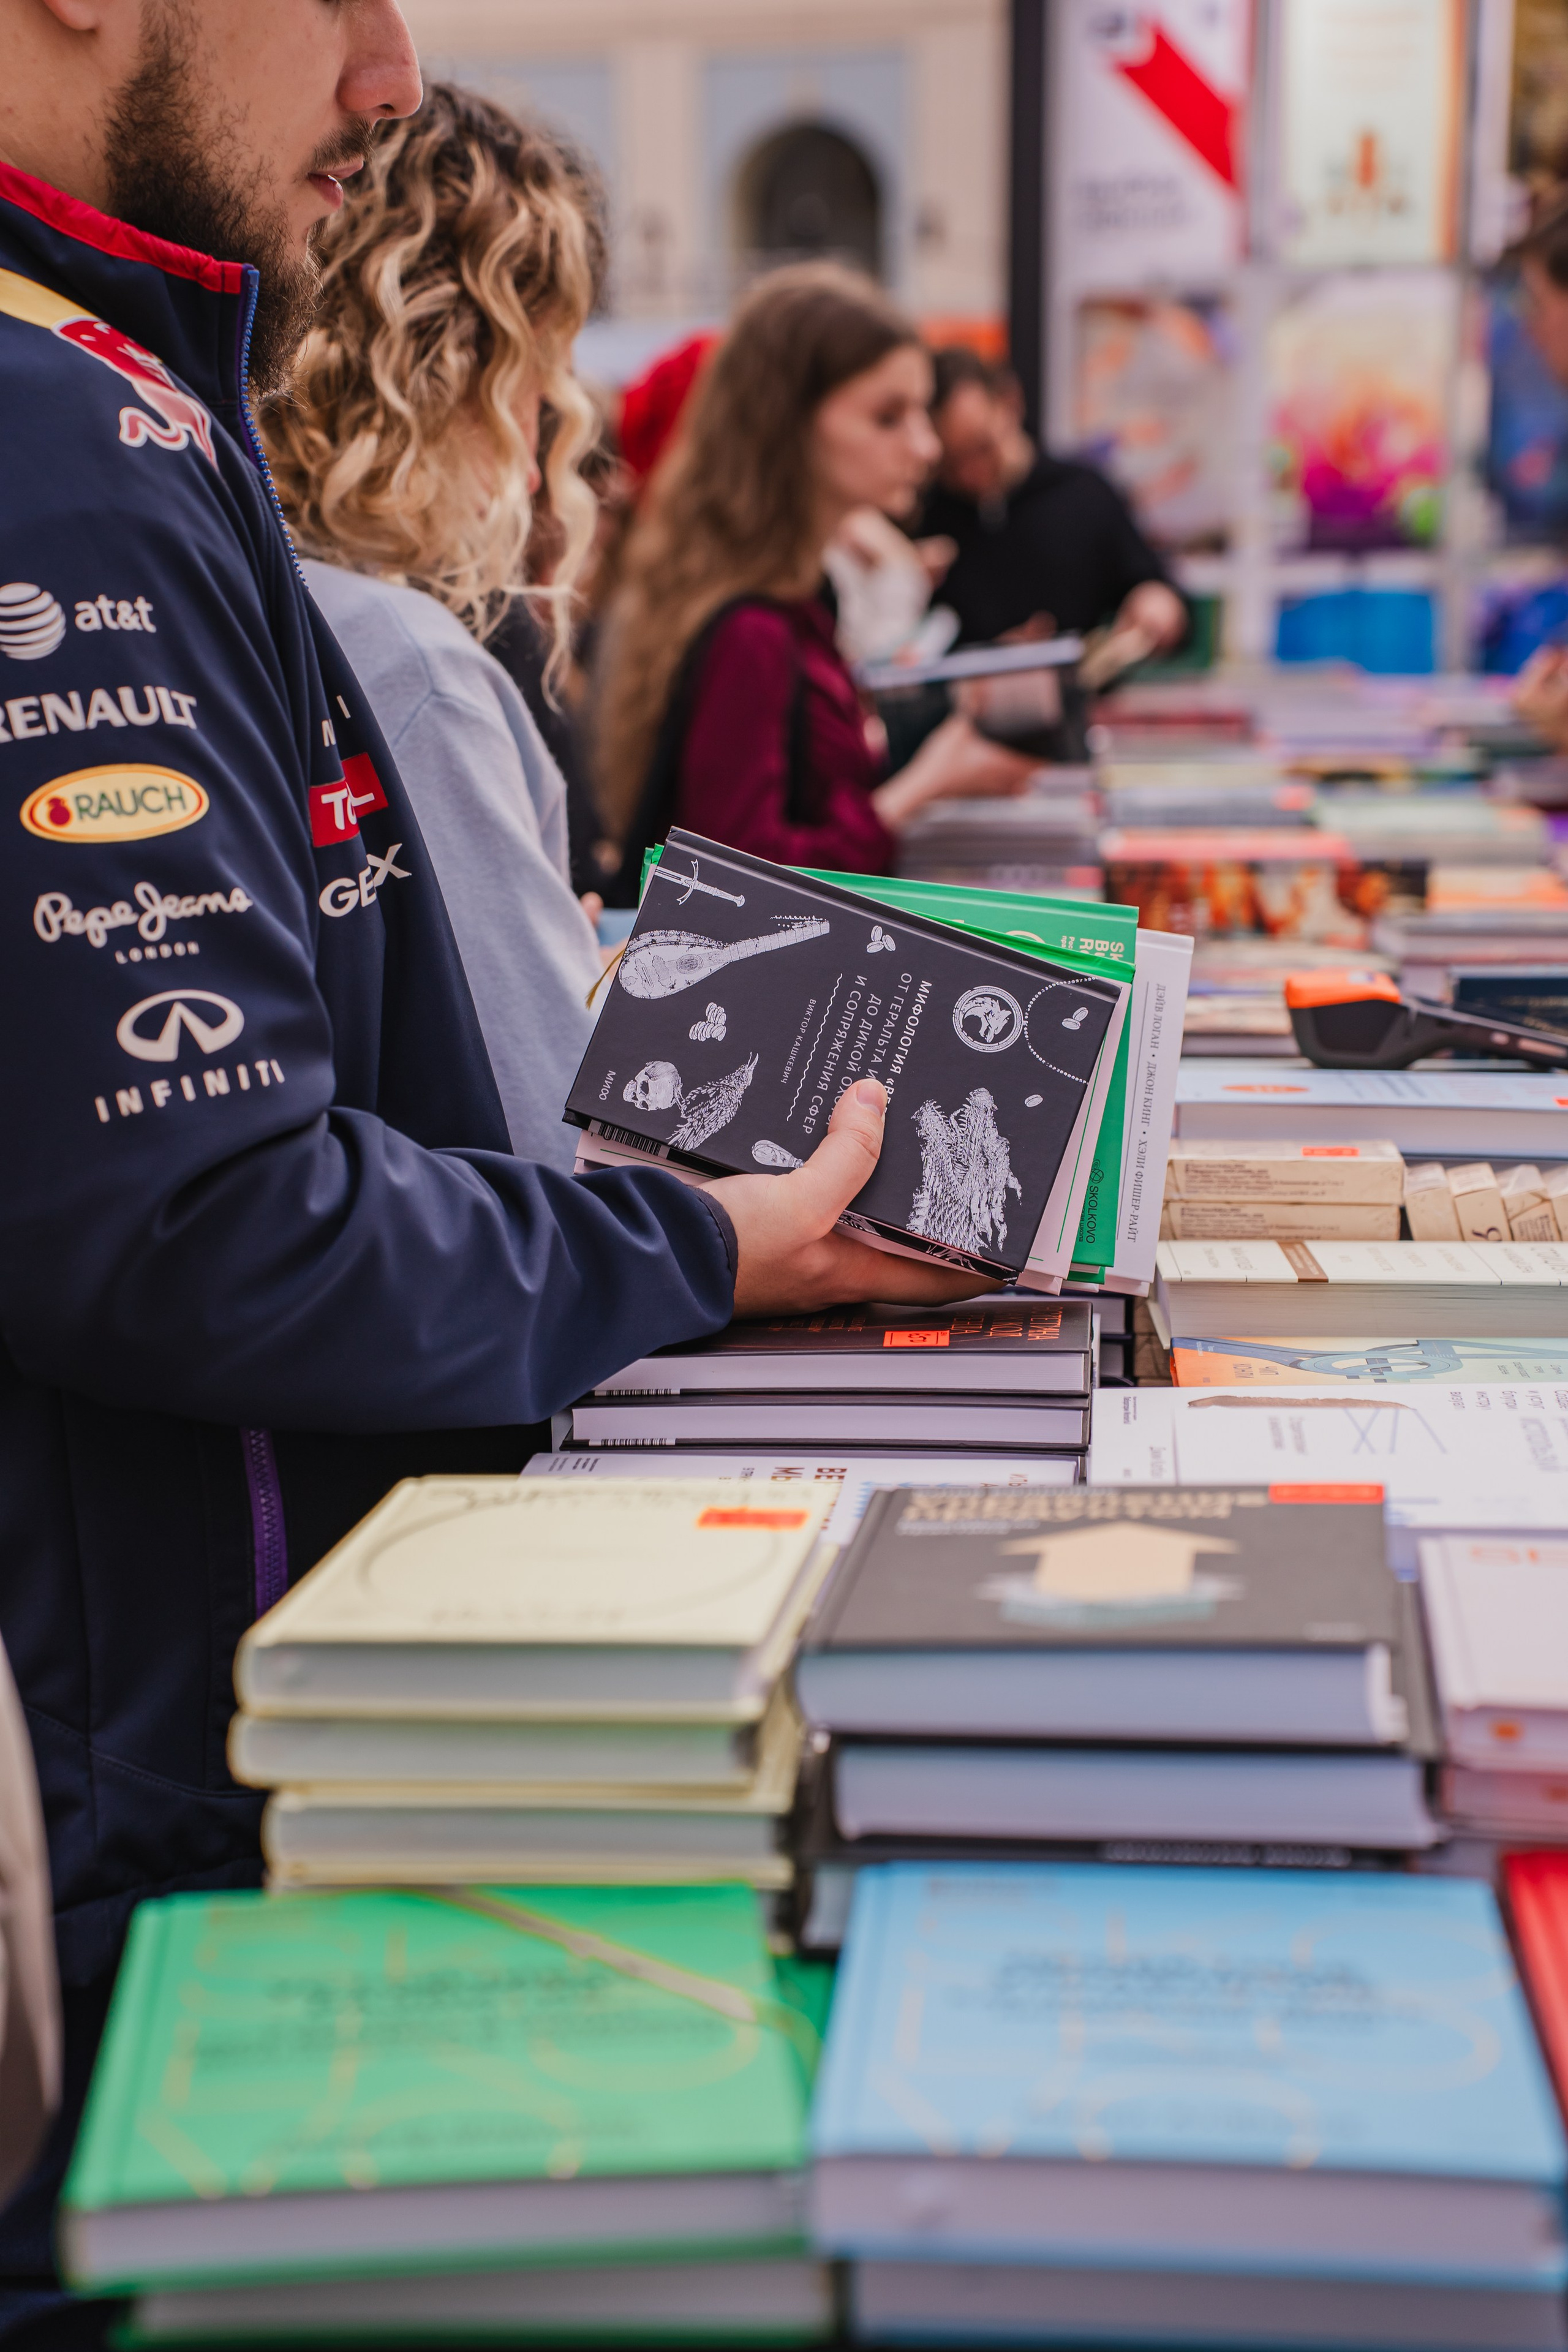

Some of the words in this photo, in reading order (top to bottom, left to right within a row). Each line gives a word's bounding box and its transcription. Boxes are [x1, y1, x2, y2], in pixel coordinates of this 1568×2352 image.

[75, 594, 157, 633] at&t
[76, 785, 186, 821] RAUCH
[34, 892, 140, 949] Pepe
[134, 881, 253, 942] Jeans
[115, 941, 200, 965] LONDON
[854, 974, 867, 987] И
[897, 973, 912, 993] ОТ
[1155, 983, 1167, 1012] ДЭЙВ
[799, 998, 816, 1034] ВИКТОР
[867, 993, 882, 1016] ДО
[816, 990, 862, 1091] СОПРЯЖЕНИЯ
[870, 995, 905, 1063] ГЕРАЛЬТА
[890, 979, 932, 1074] МИФОЛОГИЯ
[1150, 1014, 1163, 1049] ЛОГАН
[780, 1035, 804, 1084] КАШКЕВИЧ
[846, 1018, 873, 1072] ДИКОЙ
[94, 1058, 285, 1123] INFINITI
[865, 1068, 878, 1080] И
[1144, 1061, 1157, 1095] ДЖОН
[802, 1095, 823, 1134] СФЕР
[1141, 1096, 1153, 1127] КИНГ
[1136, 1139, 1148, 1169] ХЭЛИ
[1085, 1185, 1099, 1243] SKOLKOVO
[1127, 1170, 1144, 1243] ФИШЕР-РАЙТ
